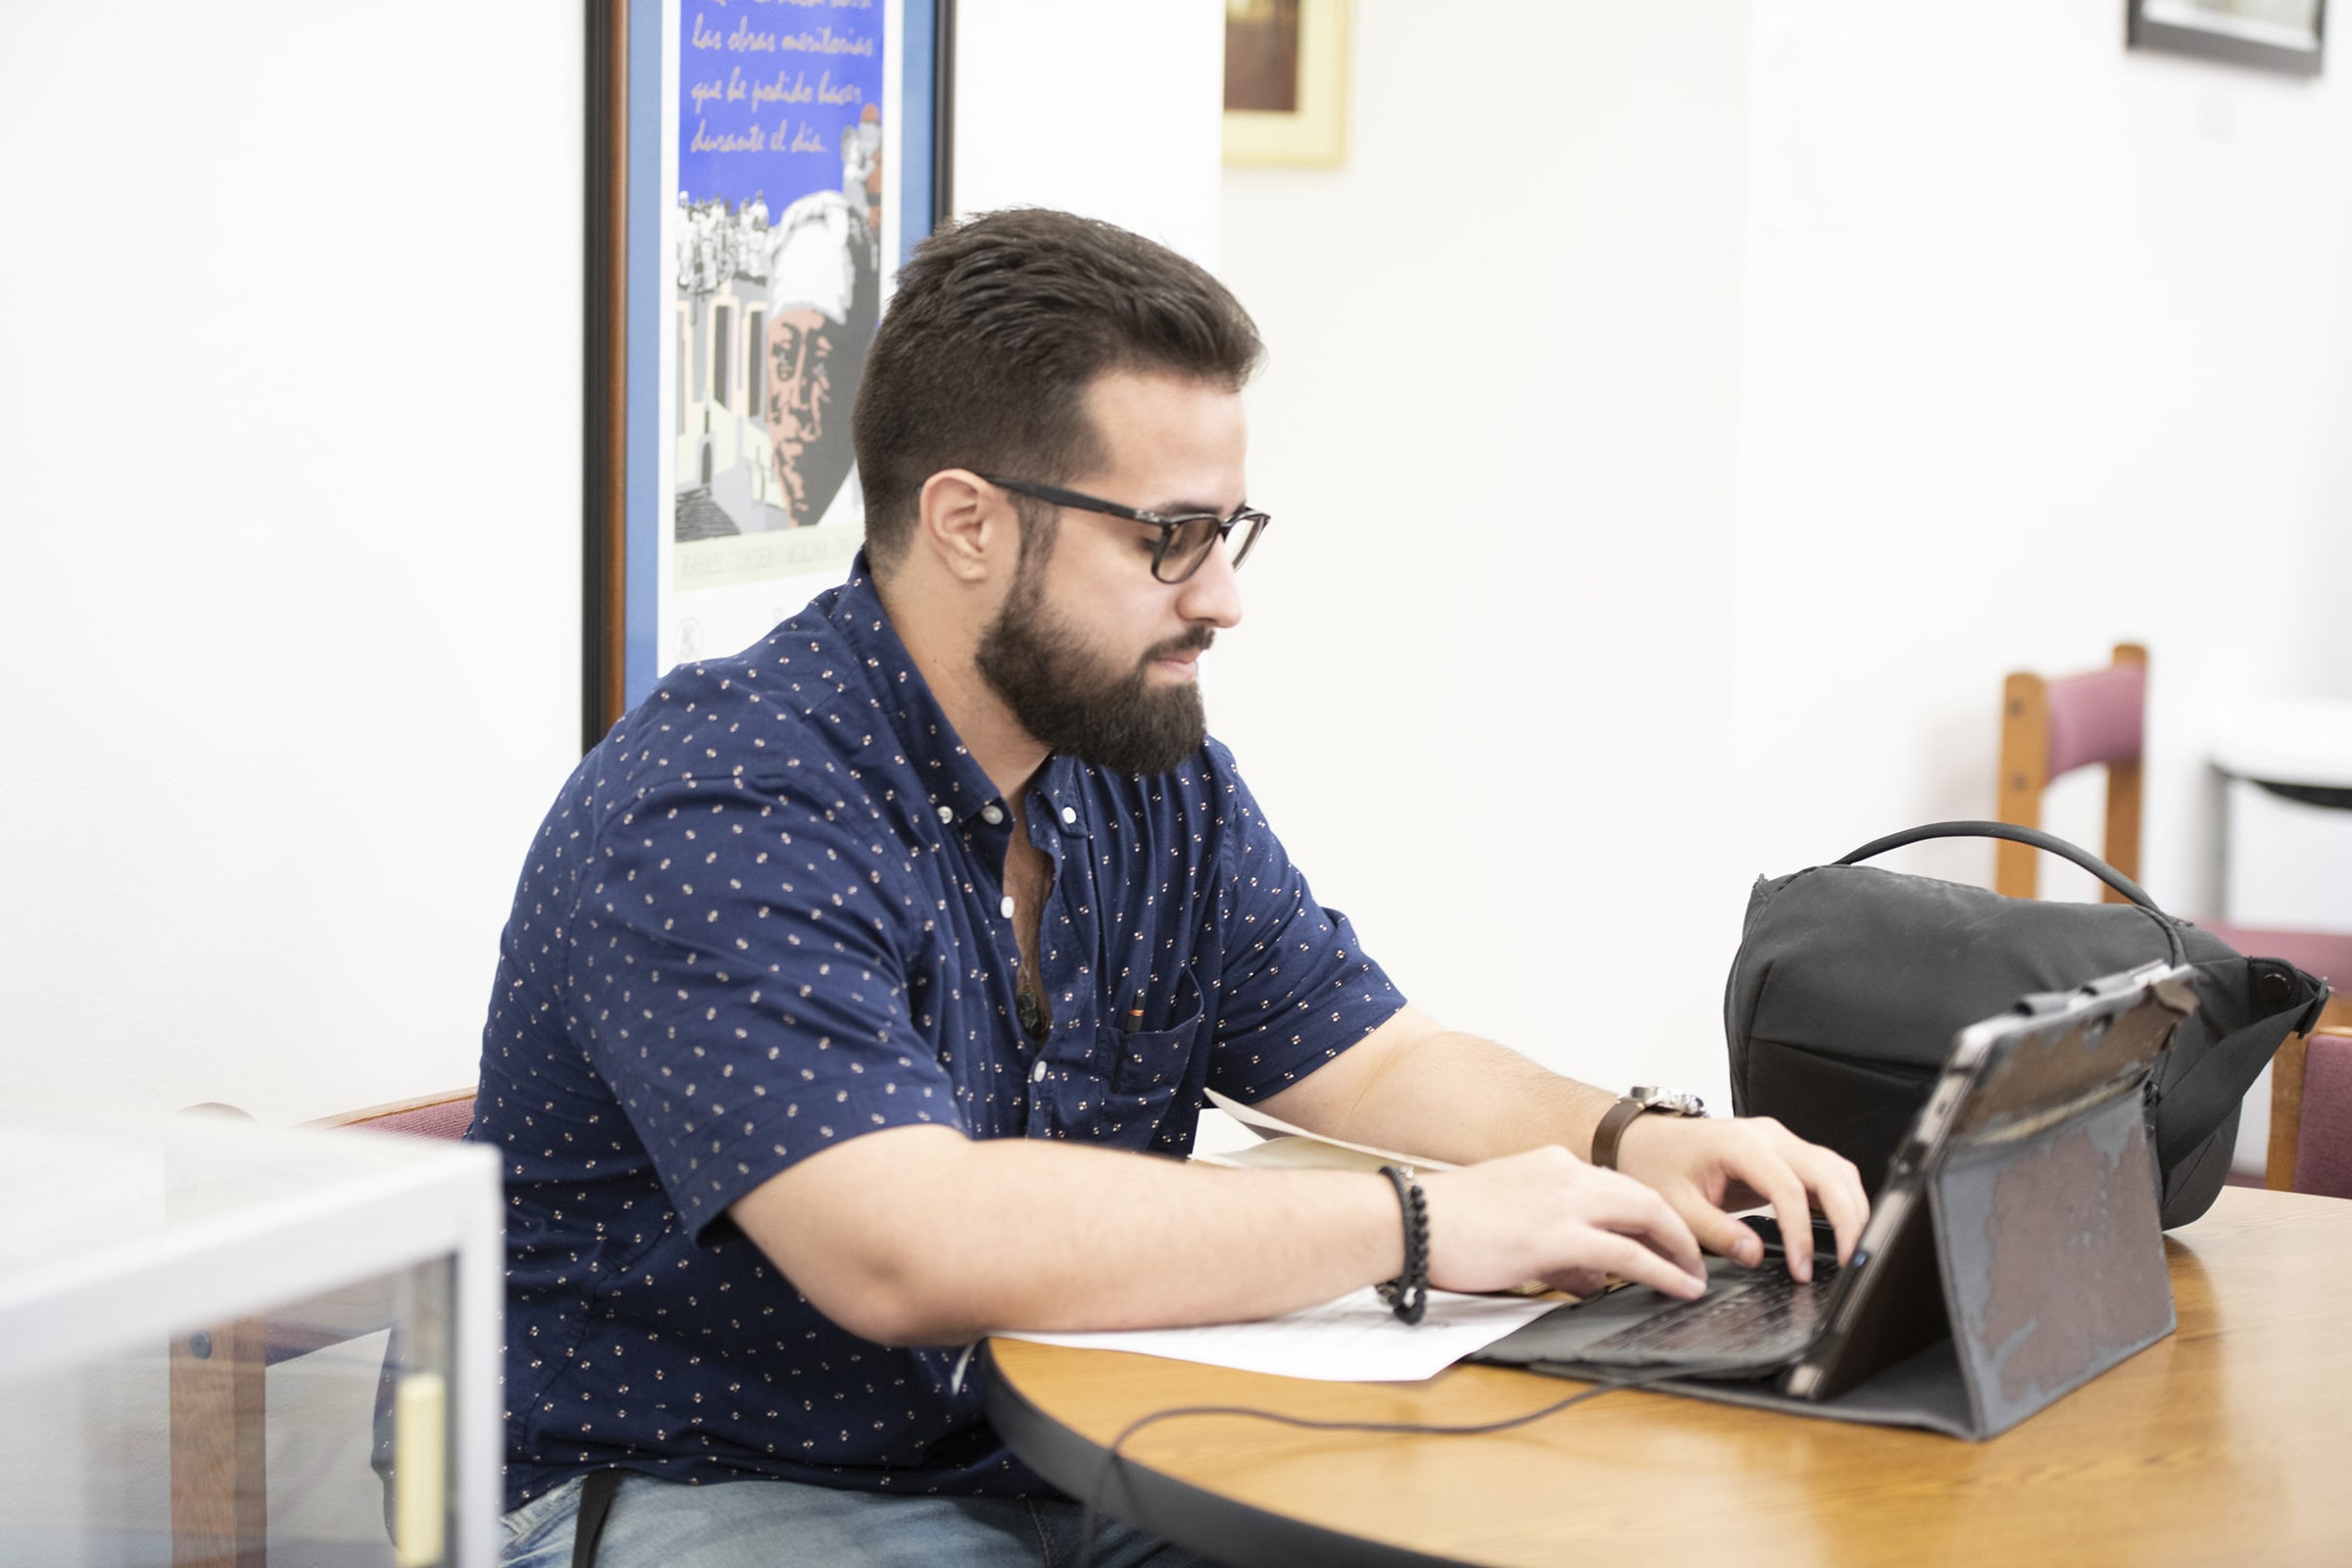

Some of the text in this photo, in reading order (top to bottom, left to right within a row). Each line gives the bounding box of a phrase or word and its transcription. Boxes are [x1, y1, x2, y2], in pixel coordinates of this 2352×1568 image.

[692, 13, 872, 57] las obras meritorias
[691, 80, 722, 115] que
[752, 71, 812, 114] podido
[691, 119, 764, 154] durante
[770, 120, 788, 152] el
